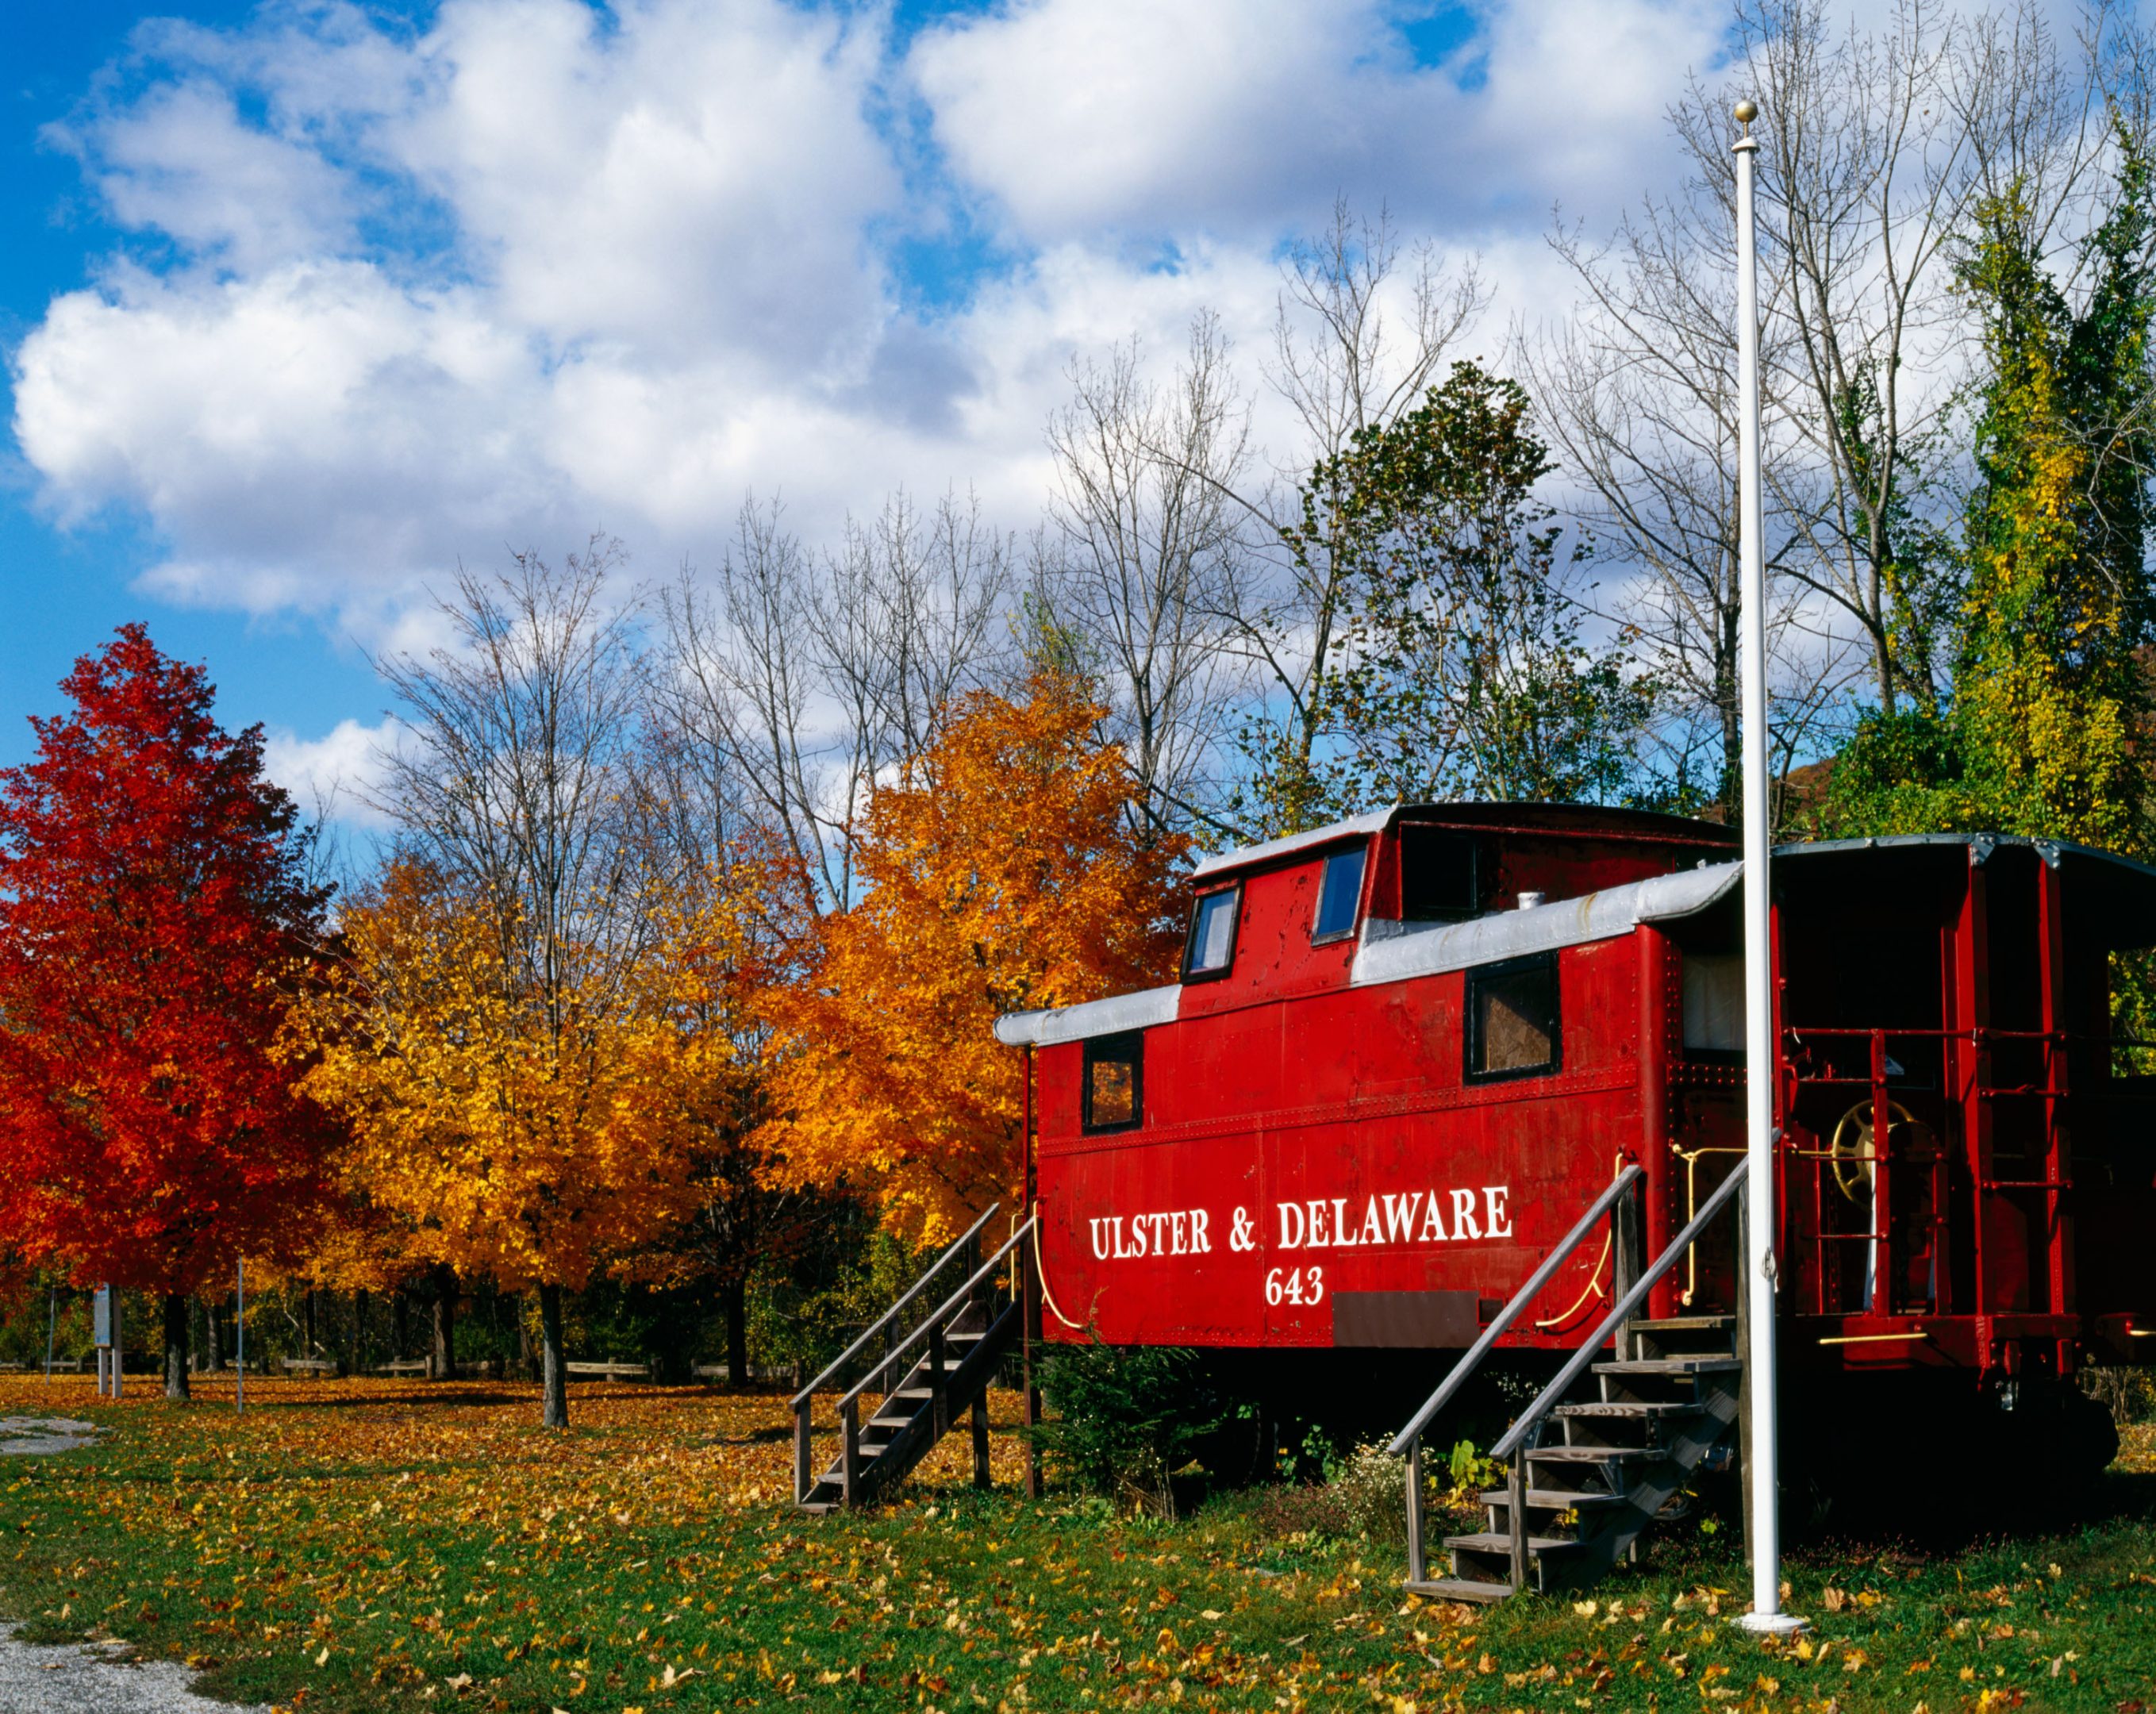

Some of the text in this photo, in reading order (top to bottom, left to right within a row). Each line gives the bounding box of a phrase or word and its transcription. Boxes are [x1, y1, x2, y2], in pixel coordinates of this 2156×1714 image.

[1089, 1186, 1512, 1260] ULSTER & DELAWARE
[1265, 1266, 1324, 1306] 643
